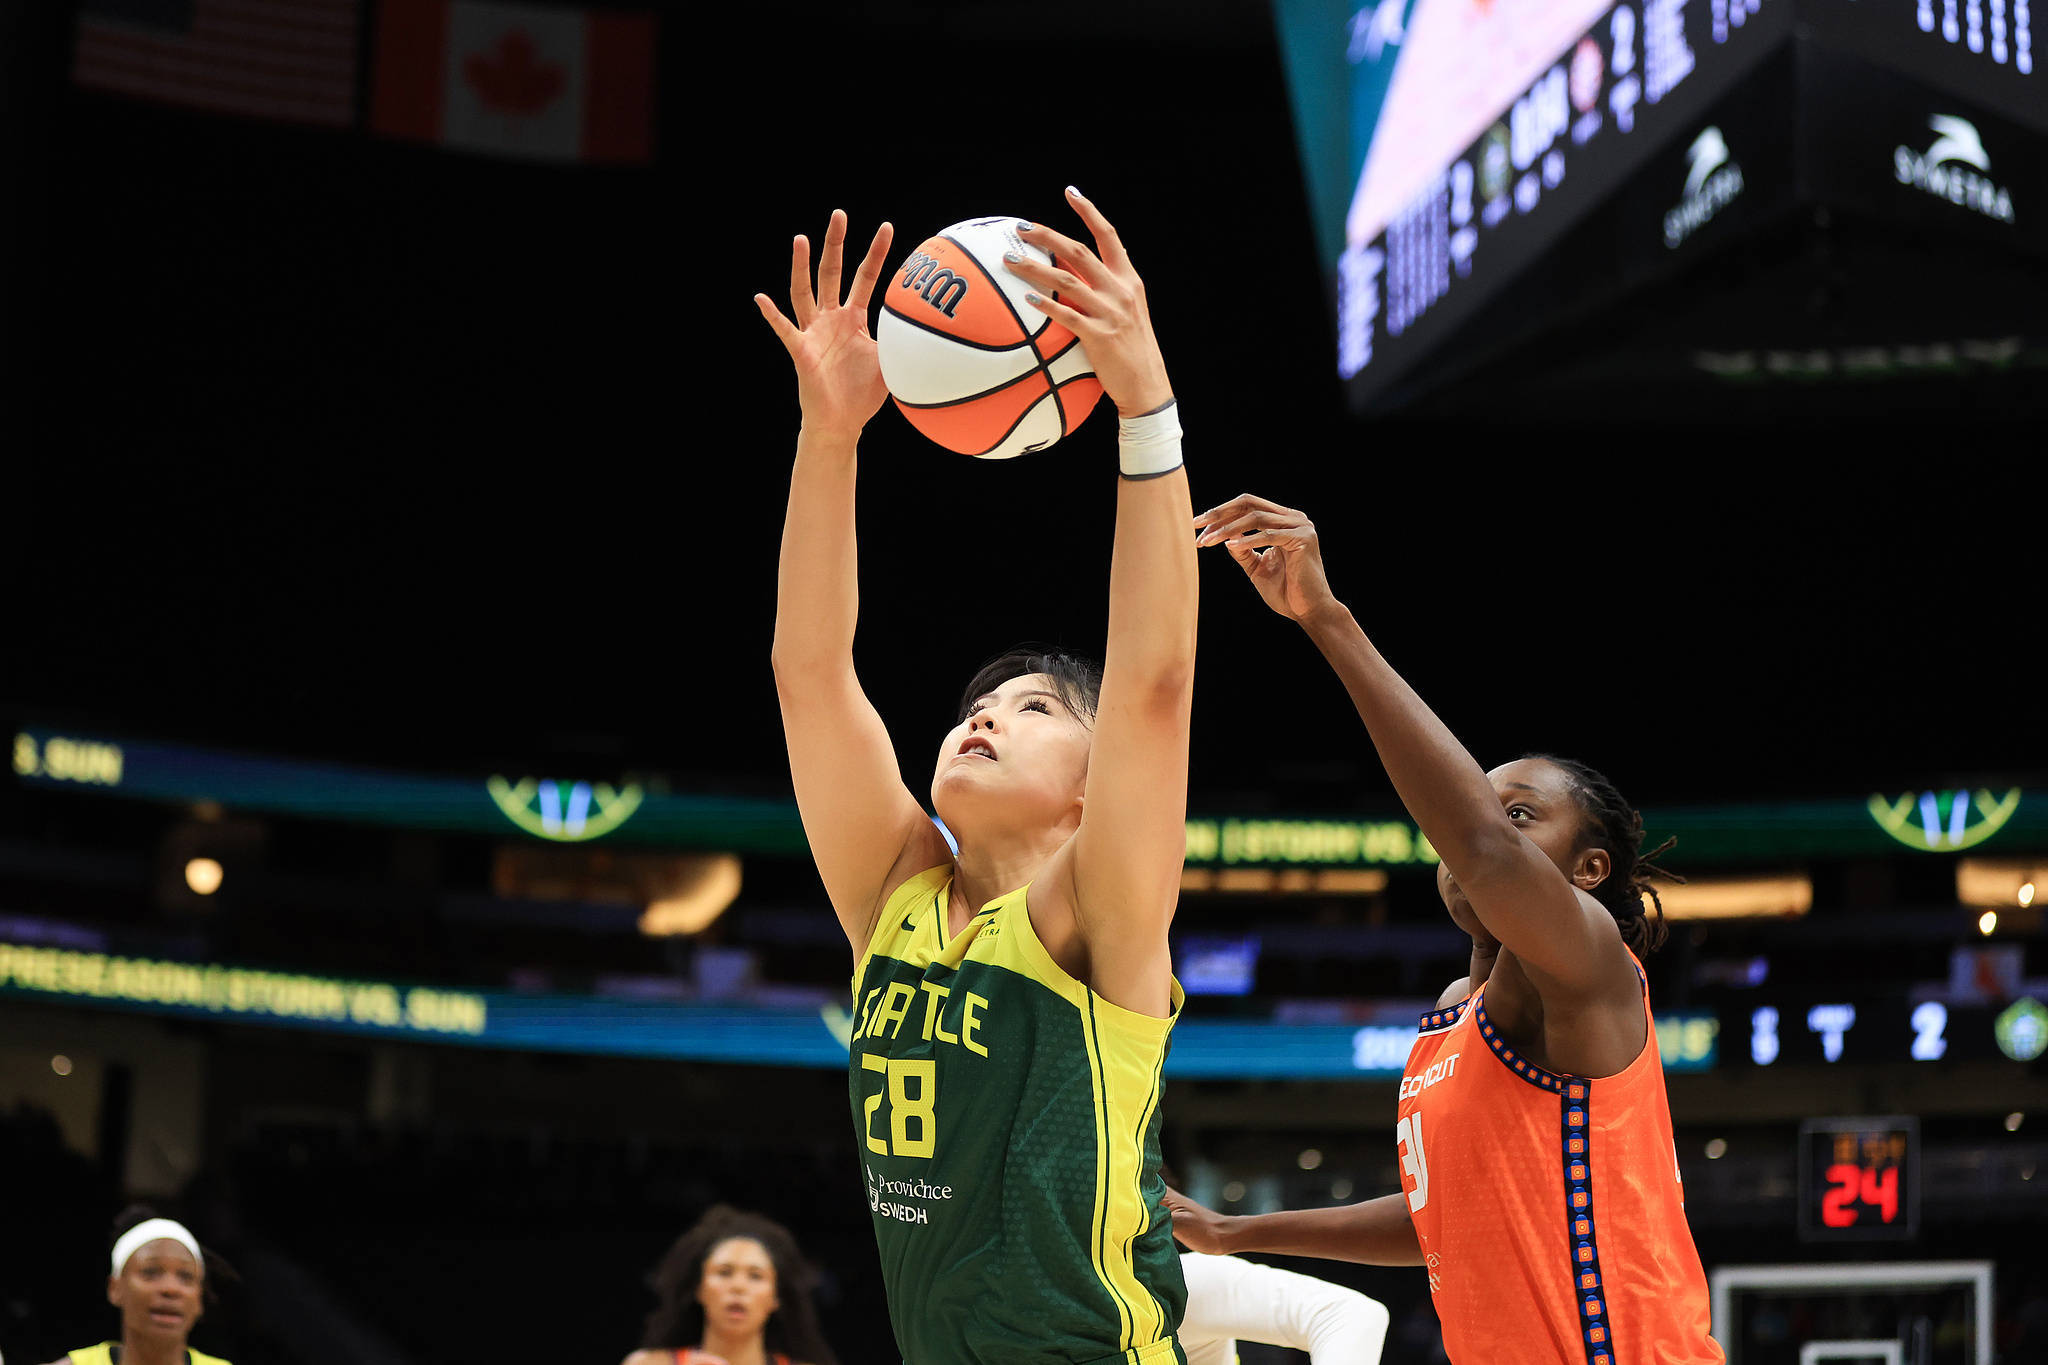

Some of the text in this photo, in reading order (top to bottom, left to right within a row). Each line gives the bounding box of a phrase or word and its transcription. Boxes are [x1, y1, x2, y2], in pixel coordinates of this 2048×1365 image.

[901, 251, 968, 319] Wils
[861, 1052, 936, 1159] 28
[1822, 1163, 1899, 1228] 24
